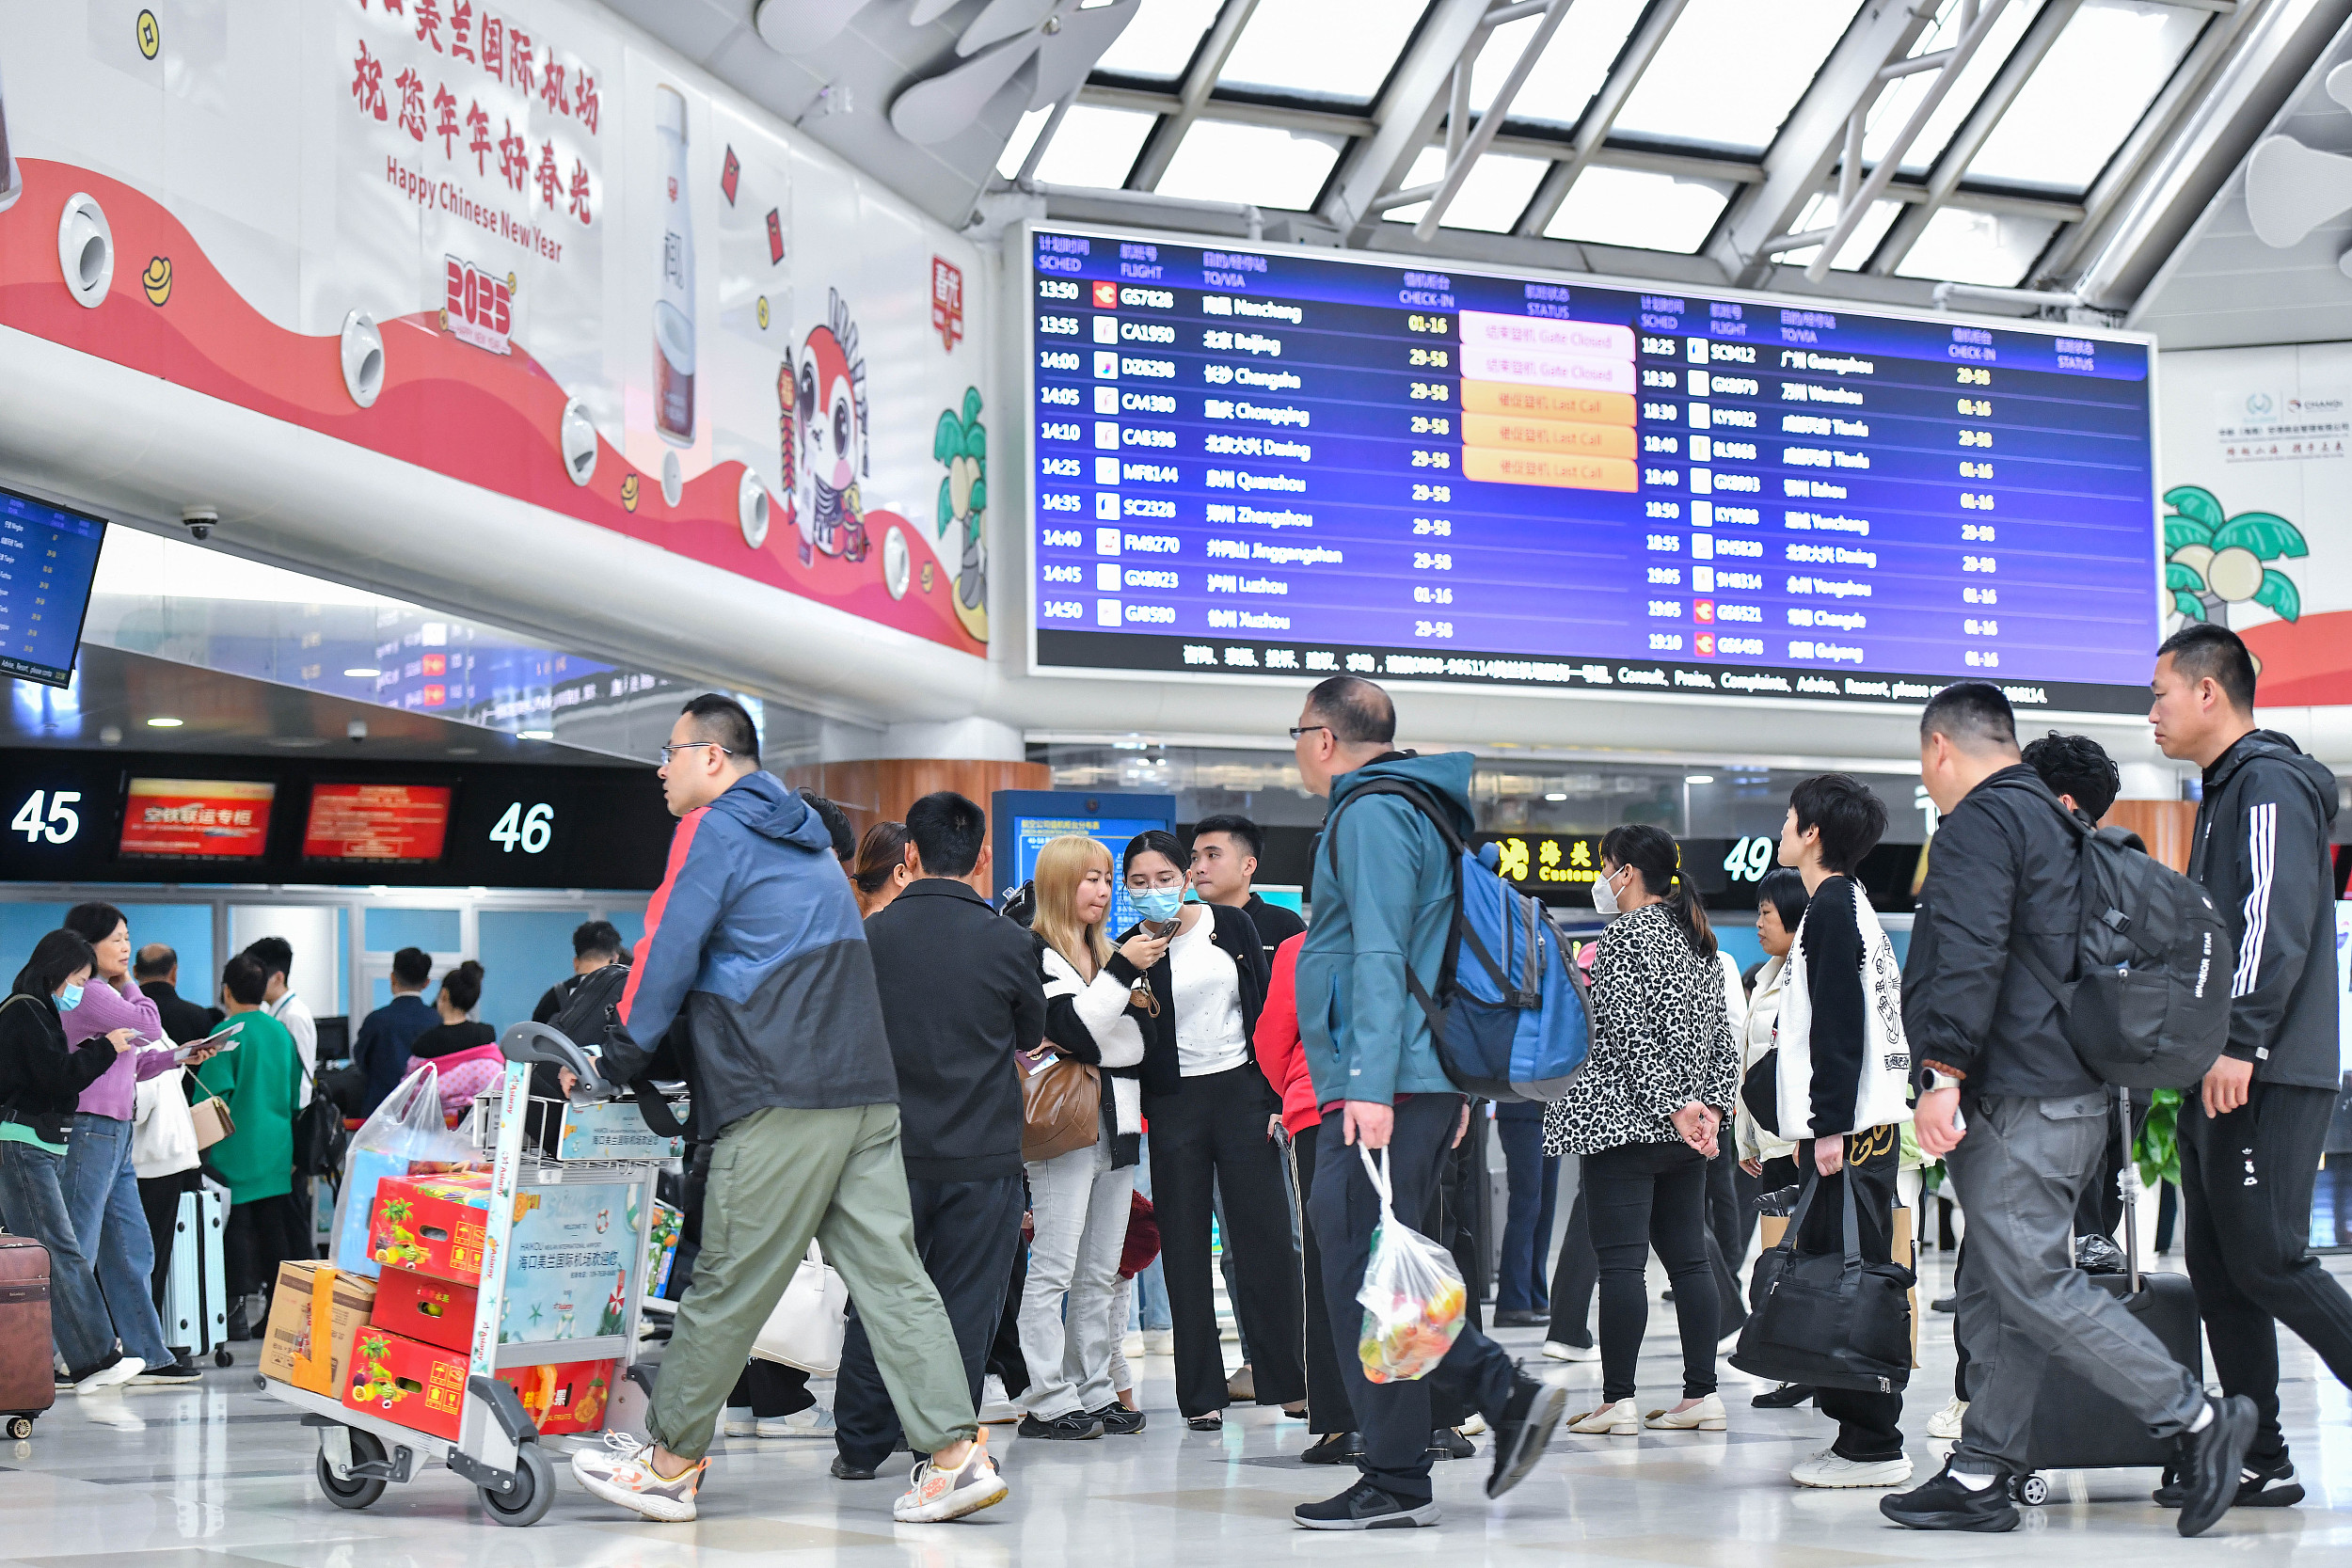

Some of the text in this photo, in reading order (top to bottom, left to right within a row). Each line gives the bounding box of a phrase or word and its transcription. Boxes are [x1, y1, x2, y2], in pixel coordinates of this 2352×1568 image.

[359, 0, 598, 135] 美兰国际机场
[353, 40, 591, 224] 祝您年年好春光
[387, 154, 563, 262] Happy Chinese New Year
[1039, 256, 1082, 272] SCHED
[1120, 263, 1163, 279] FLIGHT
[1203, 271, 1246, 288] TO/VIA
[448, 261, 511, 335] 2025
[1041, 281, 1078, 299] 13:50
[1399, 290, 1454, 308] CHECK-IN
[1234, 299, 1302, 324] Nanchang
[1527, 302, 1569, 319] STATUS
[1041, 316, 1078, 334] 13:55
[1121, 324, 1174, 342] CA1950
[1408, 315, 1447, 333] 01-16
[1235, 333, 1280, 356] Beijing
[1539, 330, 1566, 345] Gate
[1570, 332, 1613, 349] Closed
[1041, 352, 1079, 370] 14:00
[1235, 368, 1300, 390] Changsha
[1540, 364, 1567, 380] Gate
[1571, 366, 1613, 383] Closed
[1041, 388, 1079, 405] 14:05
[1235, 403, 1309, 427] Chongqing
[1553, 398, 1577, 411] Last
[1580, 400, 1601, 414] Call
[1042, 422, 1080, 440] 14:10
[1554, 432, 1578, 445] Last
[1581, 433, 1602, 447] Call
[1042, 458, 1080, 476] 14:25
[1124, 464, 1178, 483] MF8144
[1555, 466, 1578, 479] Last
[1581, 467, 1603, 481] Call
[1237, 472, 1306, 492] Quanzhou
[1043, 494, 1081, 512] 14:35
[1238, 507, 1312, 529] Zhengzhou
[1043, 530, 1081, 546] 14:40
[1252, 543, 1343, 565] Jinggangshan
[1044, 565, 1082, 582] 14:45
[1239, 577, 1287, 594] Luzhou
[1414, 587, 1453, 604] 01-16
[1044, 601, 1082, 618] 14:50
[1239, 611, 1290, 629] Xuzhou
[11, 790, 81, 844] 45
[489, 802, 554, 852] 46
[1539, 840, 1592, 866] 海关
[1724, 836, 1773, 881] 49
[1539, 865, 1601, 881] Customs
[518, 1250, 618, 1270] 海口美兰国际机场欢迎您
